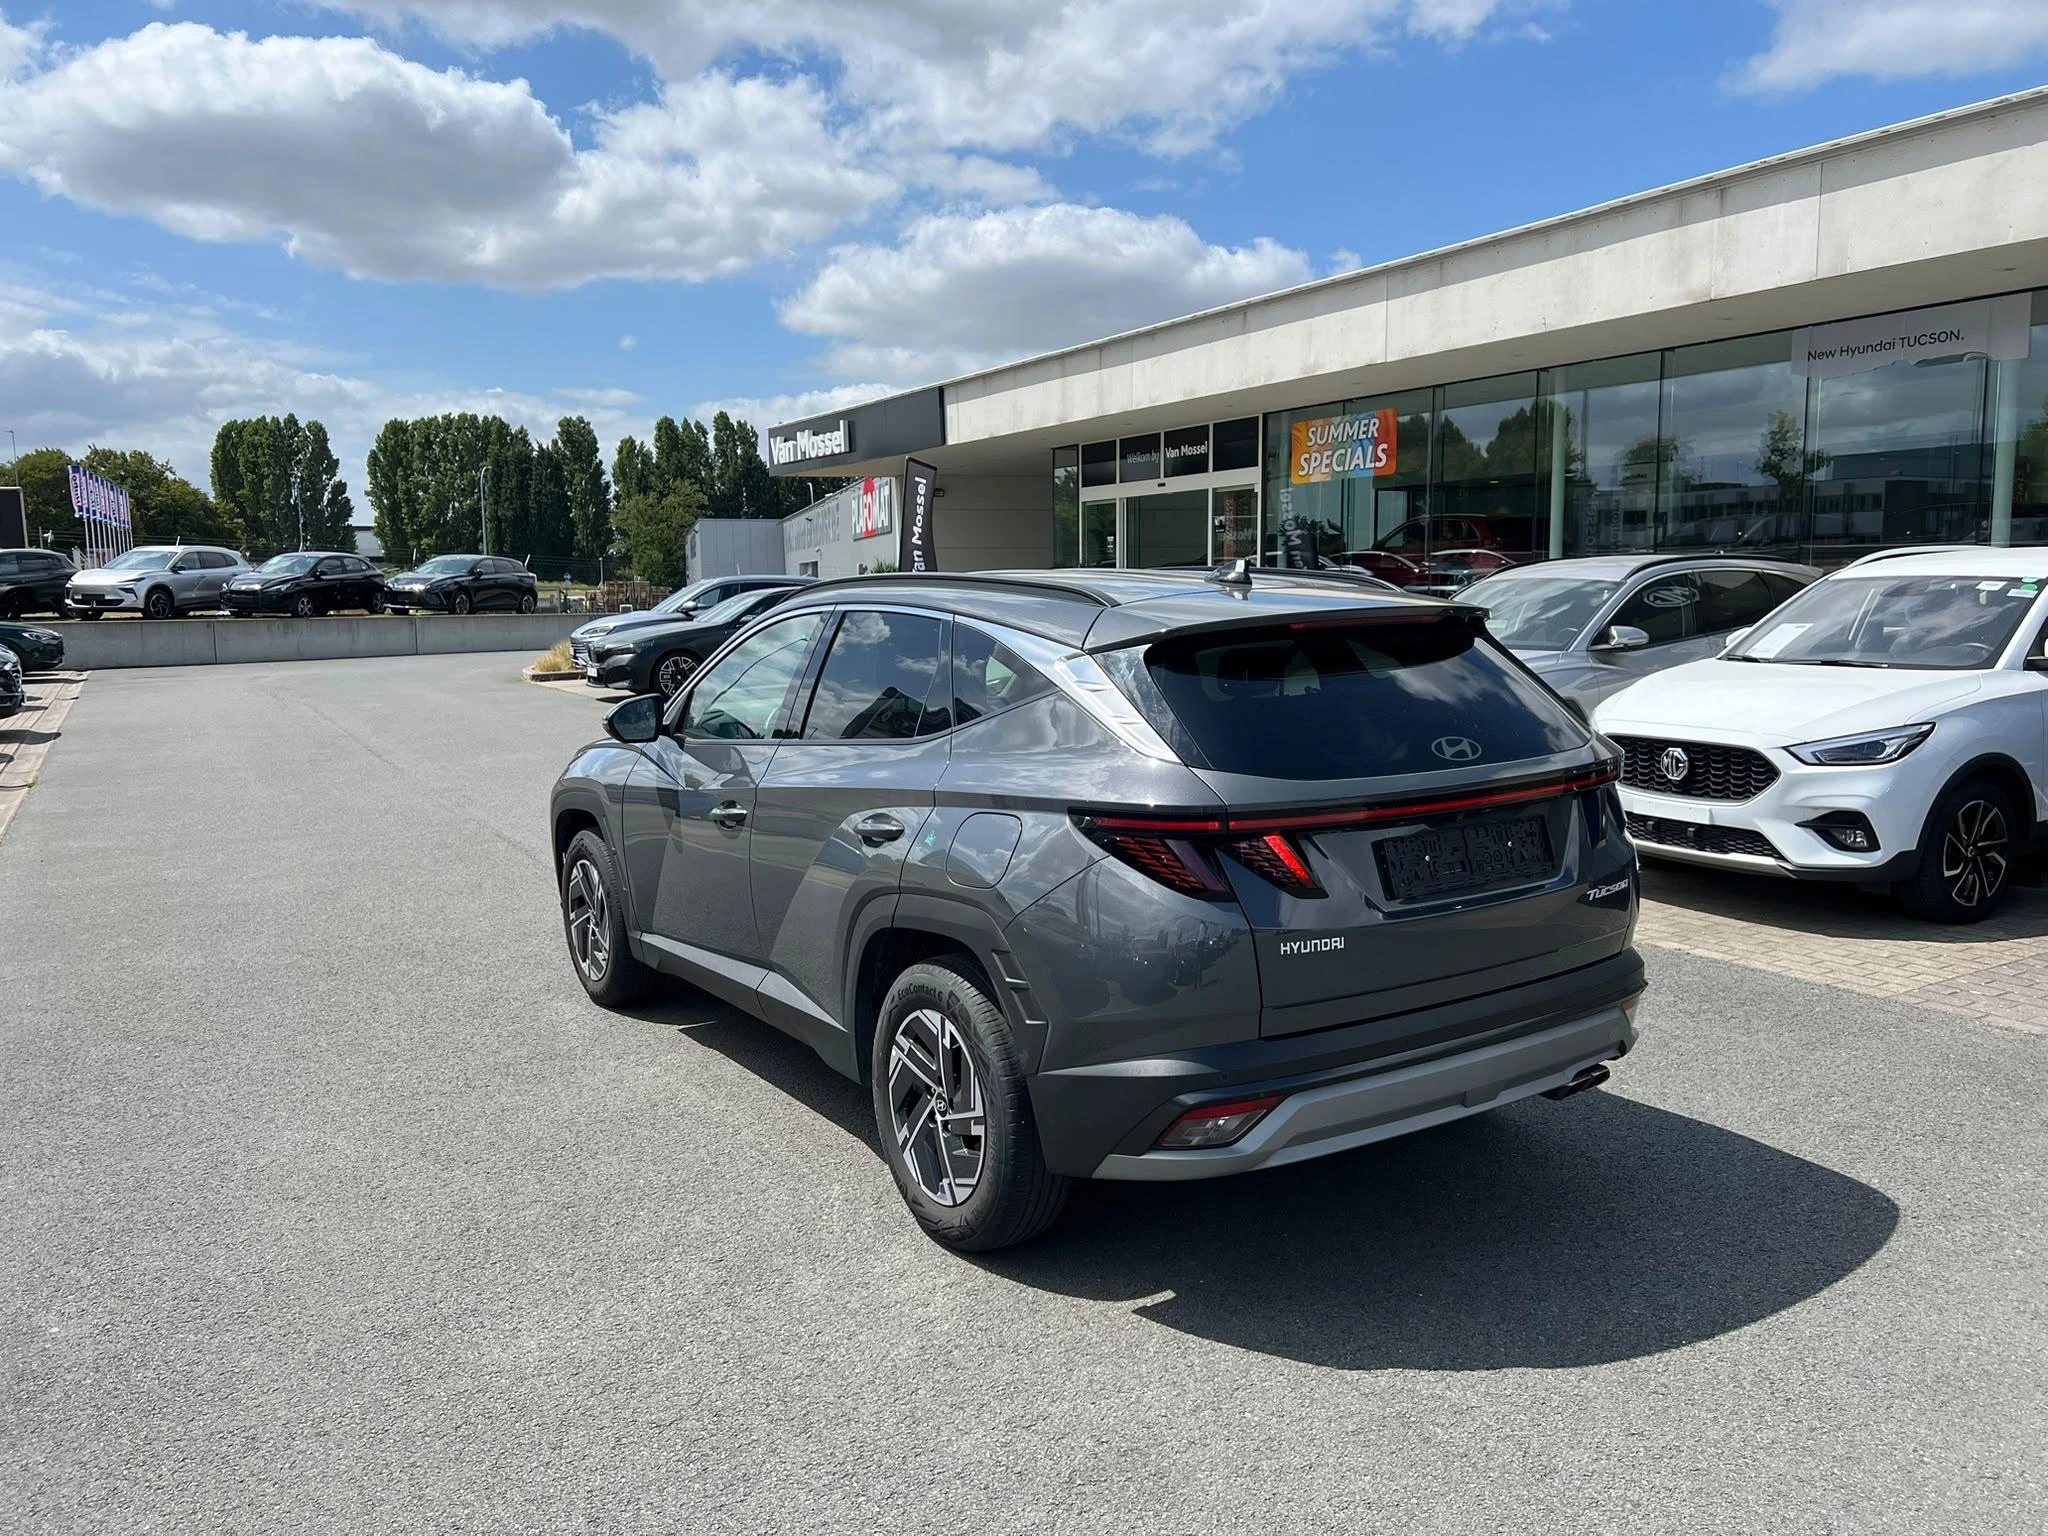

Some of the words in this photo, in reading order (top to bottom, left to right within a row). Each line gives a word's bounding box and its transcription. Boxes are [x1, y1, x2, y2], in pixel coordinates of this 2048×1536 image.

[1807, 350, 1836, 362] New
[1839, 338, 1895, 358] Hyundai
[1899, 329, 1964, 349] TUCSON.
[770, 436, 797, 465] Van
[797, 420, 848, 461] Mossel
[1307, 418, 1380, 447] SUMMER
[1126, 451, 1150, 463] Welkom
[1151, 449, 1160, 463] bij
[1165, 447, 1179, 459] Van
[1180, 441, 1208, 457] Mossel
[1298, 443, 1389, 477] SPECIALS
[911, 476, 927, 546] Mossel
[1662, 750, 1686, 778] MG
[1280, 936, 1344, 955] HYUNDAI
